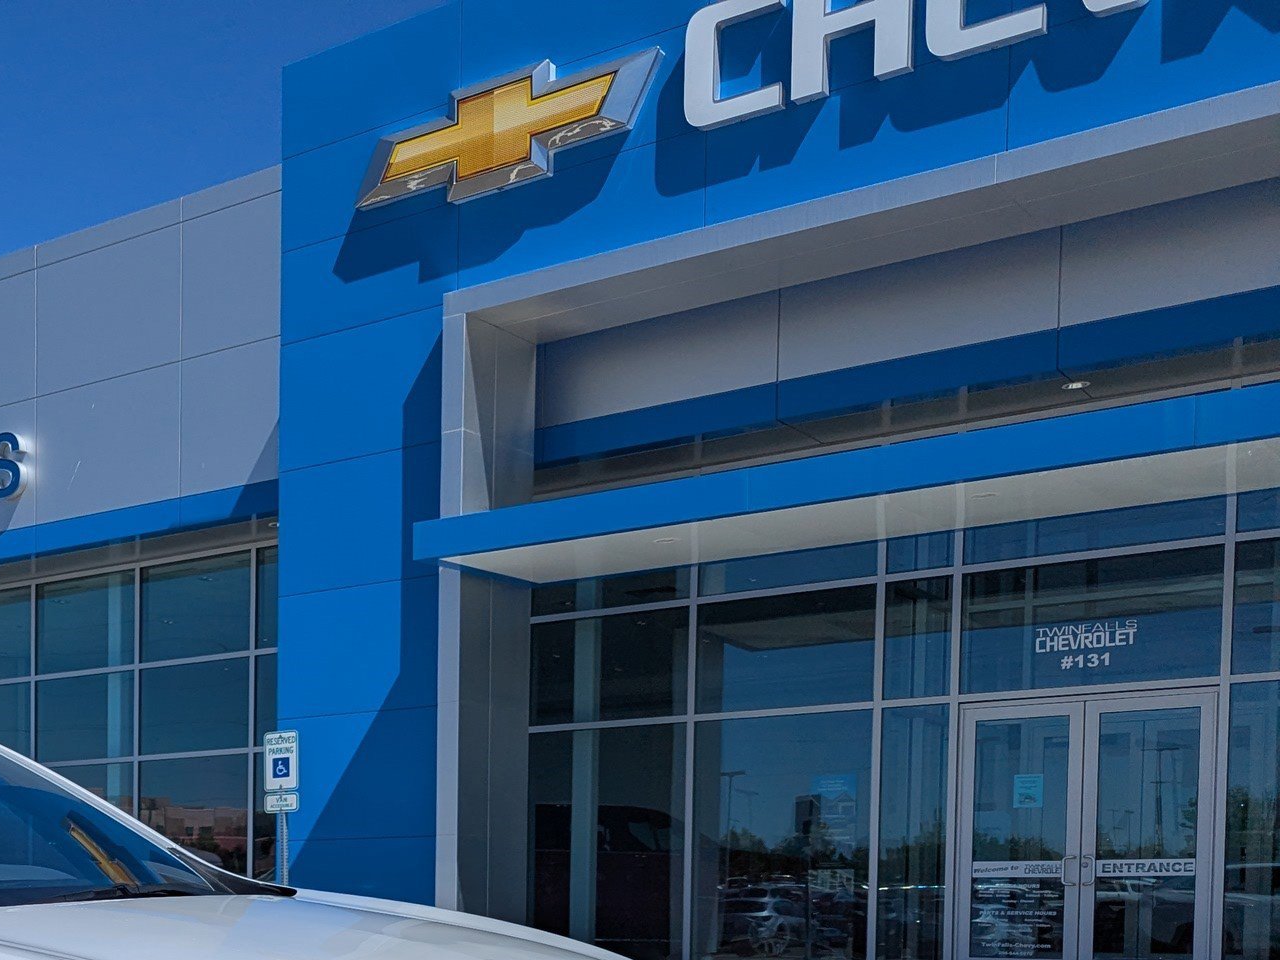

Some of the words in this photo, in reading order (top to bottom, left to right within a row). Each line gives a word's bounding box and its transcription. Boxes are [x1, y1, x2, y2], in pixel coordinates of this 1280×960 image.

[683, 0, 1150, 131] CH
[1036, 619, 1138, 638] TWINFALLS
[1035, 629, 1138, 653] CHEVROLET
[1060, 652, 1110, 670] #131
[266, 735, 296, 746] RESERVED
[268, 746, 294, 756] PARKING
[973, 866, 1009, 874] Welcome
[1024, 867, 1062, 875] CHEVROLE
[1101, 862, 1195, 874] ENTRANCE
